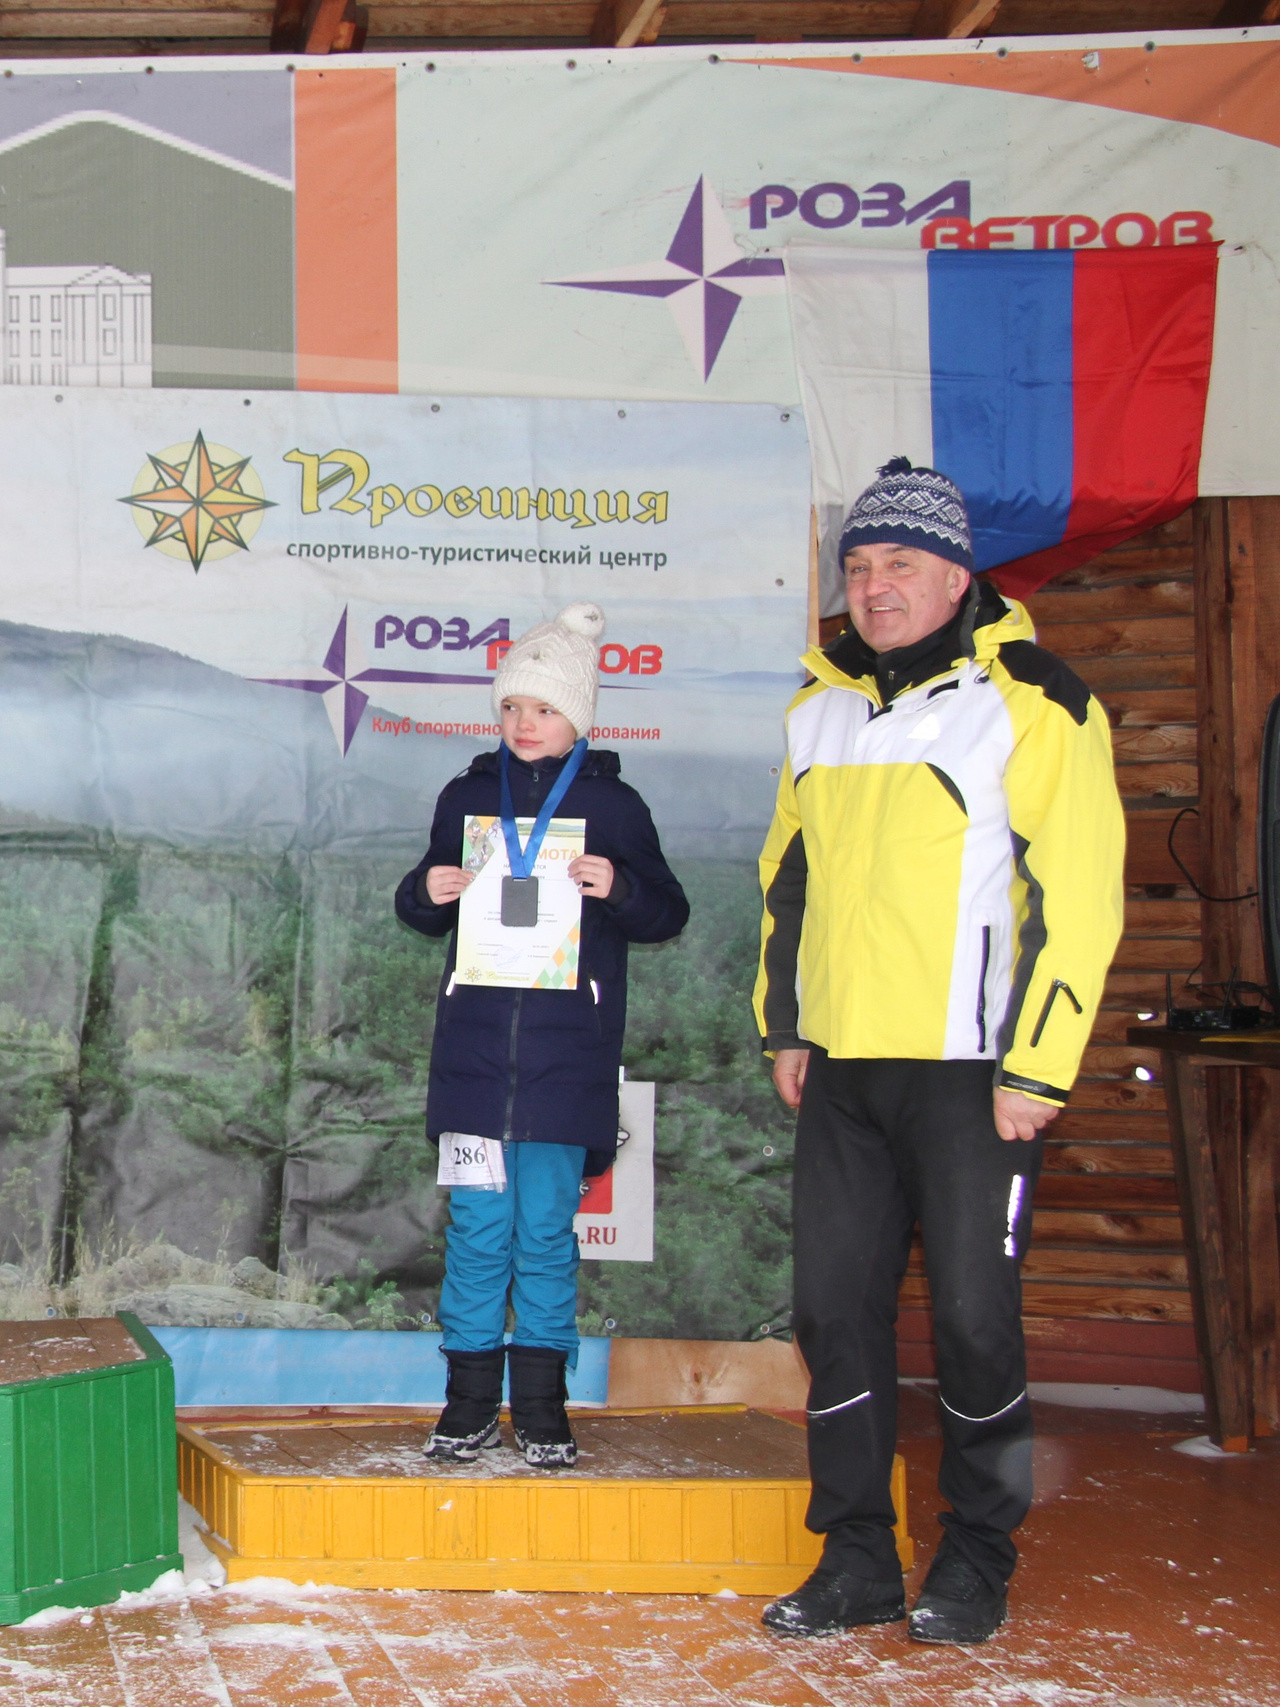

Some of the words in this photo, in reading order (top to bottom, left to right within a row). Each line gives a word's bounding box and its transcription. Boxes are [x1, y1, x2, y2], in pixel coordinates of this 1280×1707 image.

[749, 180, 970, 229] РОЗА
[920, 211, 1214, 250] ВЕТРОВ
[283, 448, 669, 528] Провинция
[286, 542, 591, 566] спортивно-туристический
[599, 550, 668, 571] центр
[374, 615, 510, 650] РОЗА
[372, 717, 412, 737] Клуб
[415, 721, 502, 738] спортивно
[454, 1146, 486, 1165] 286
[577, 1226, 617, 1245] .RU
